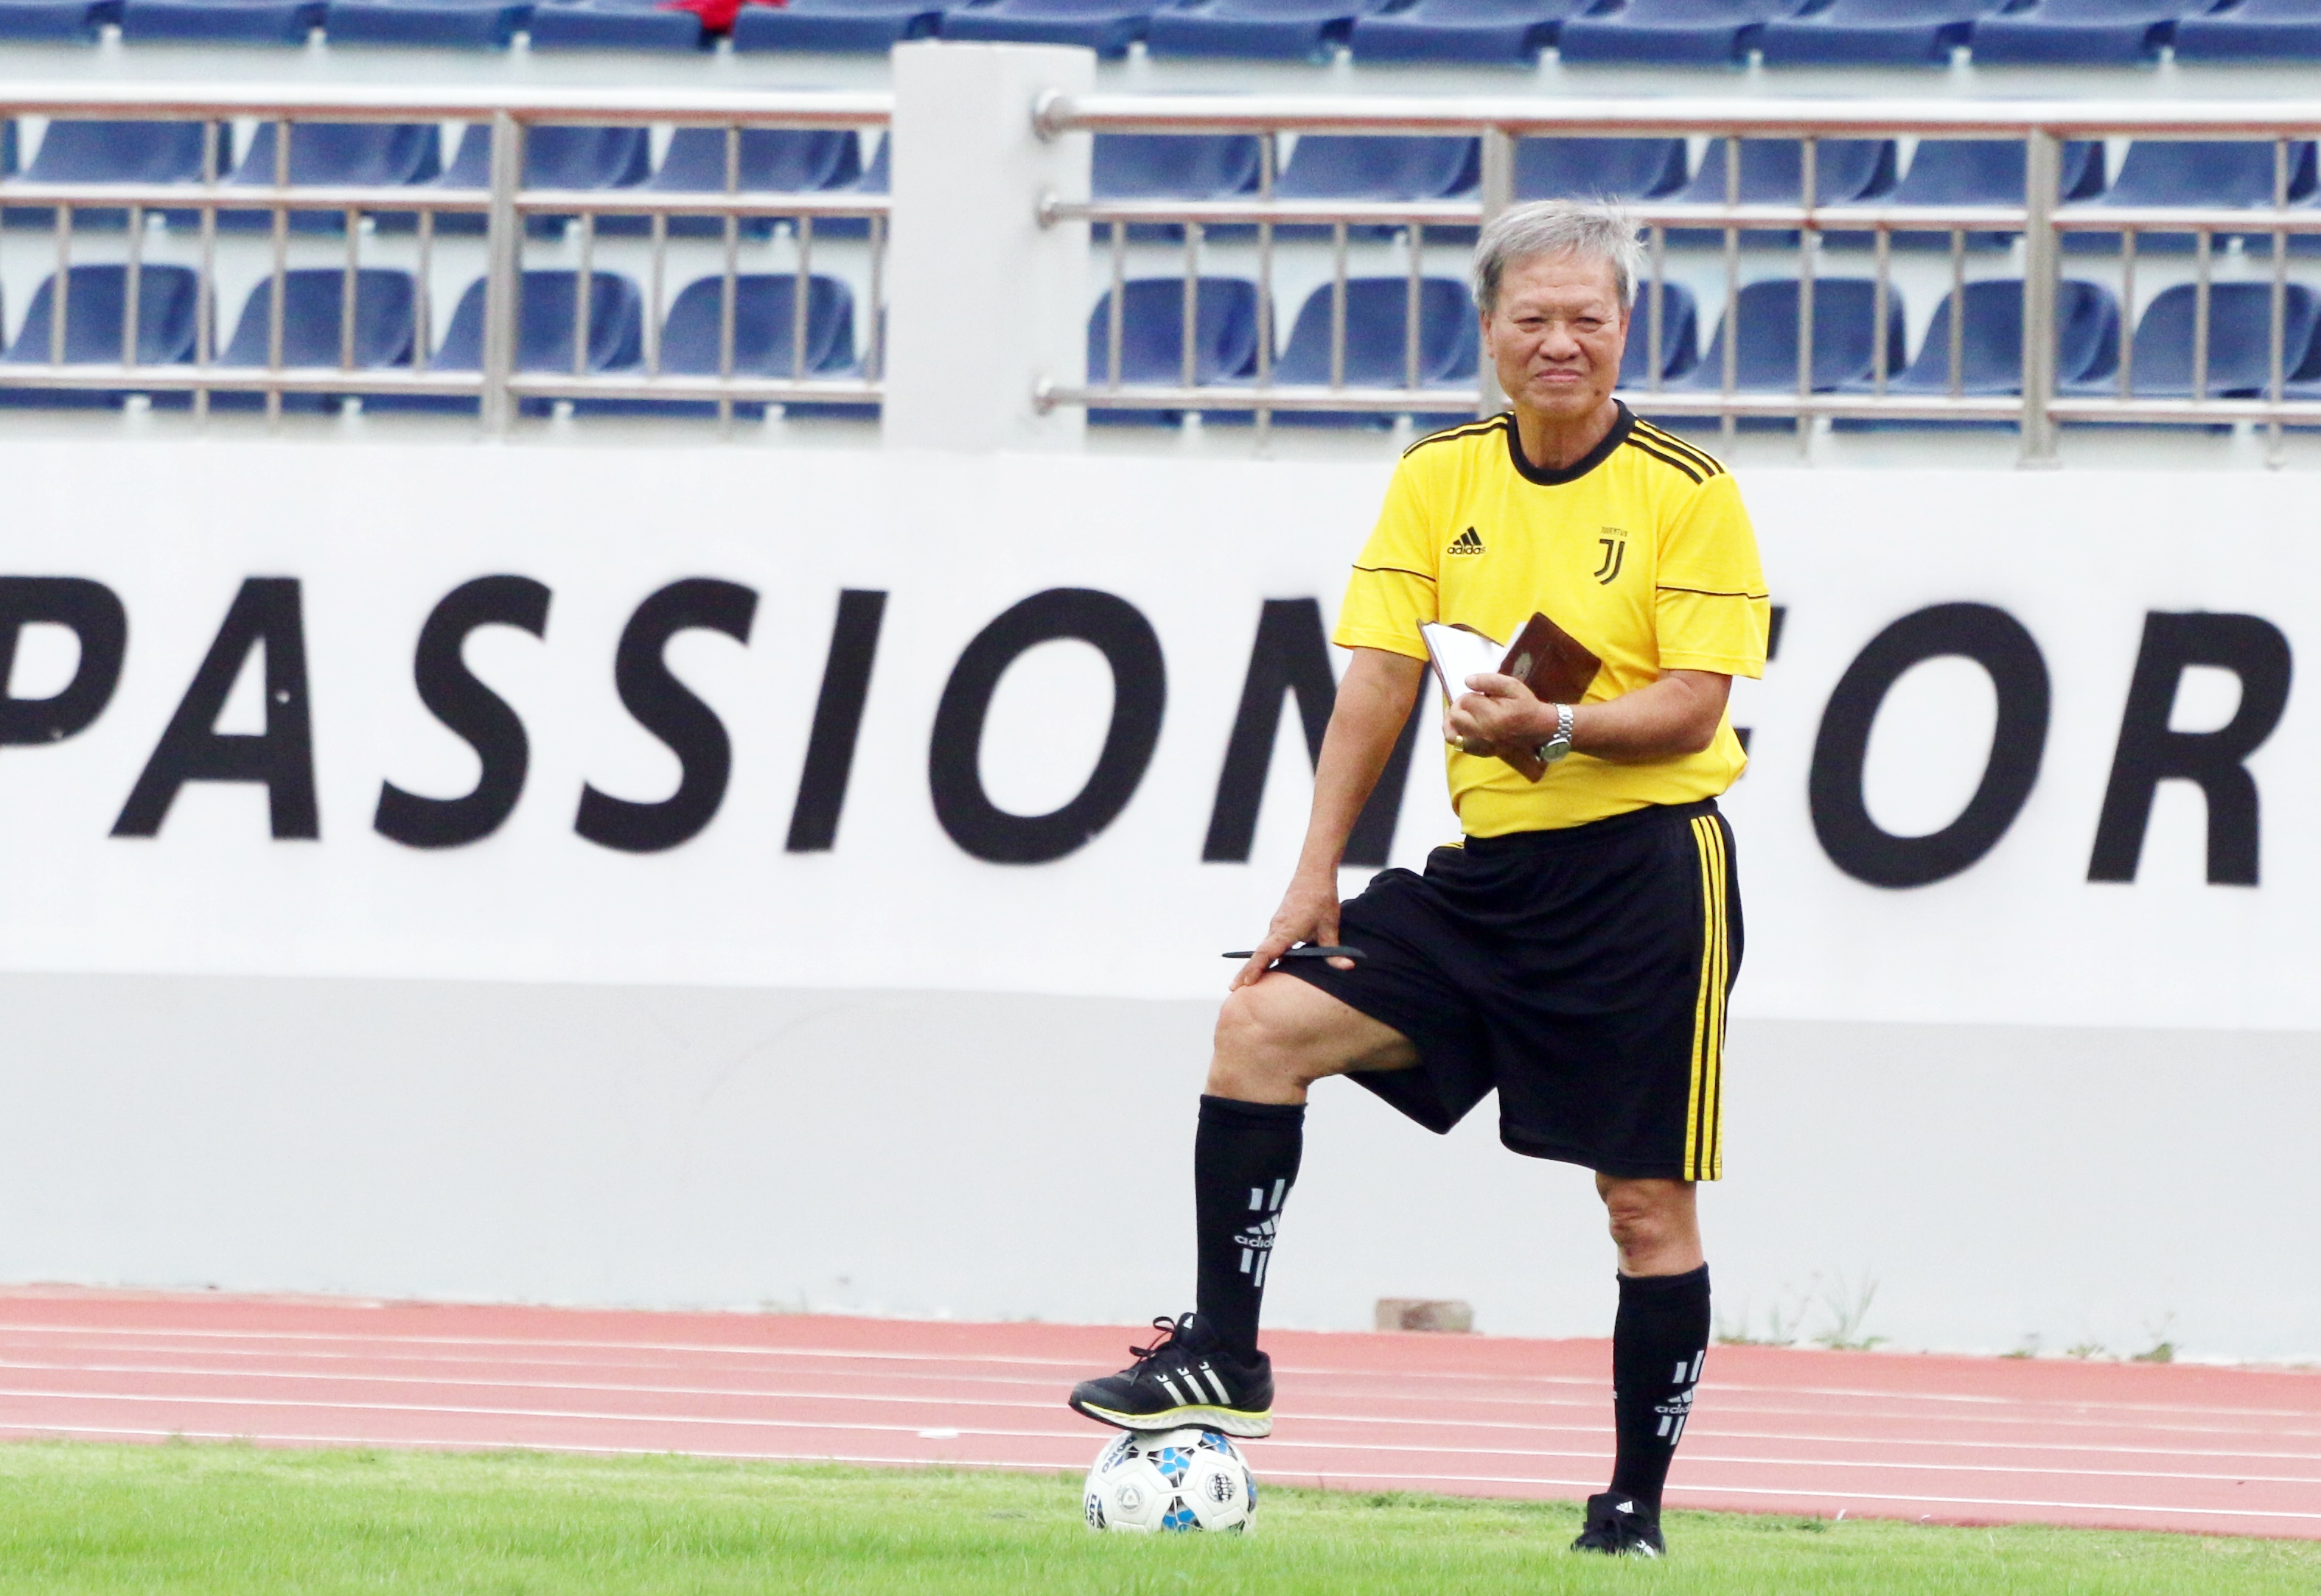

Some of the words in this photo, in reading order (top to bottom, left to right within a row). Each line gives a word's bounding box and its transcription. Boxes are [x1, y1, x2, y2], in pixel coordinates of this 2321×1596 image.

[1447, 545, 1486, 555] adidas
[1739, 601, 2294, 889] OR
[1234, 1235, 1274, 1247] adid
[1654, 1403, 1692, 1414] adid
